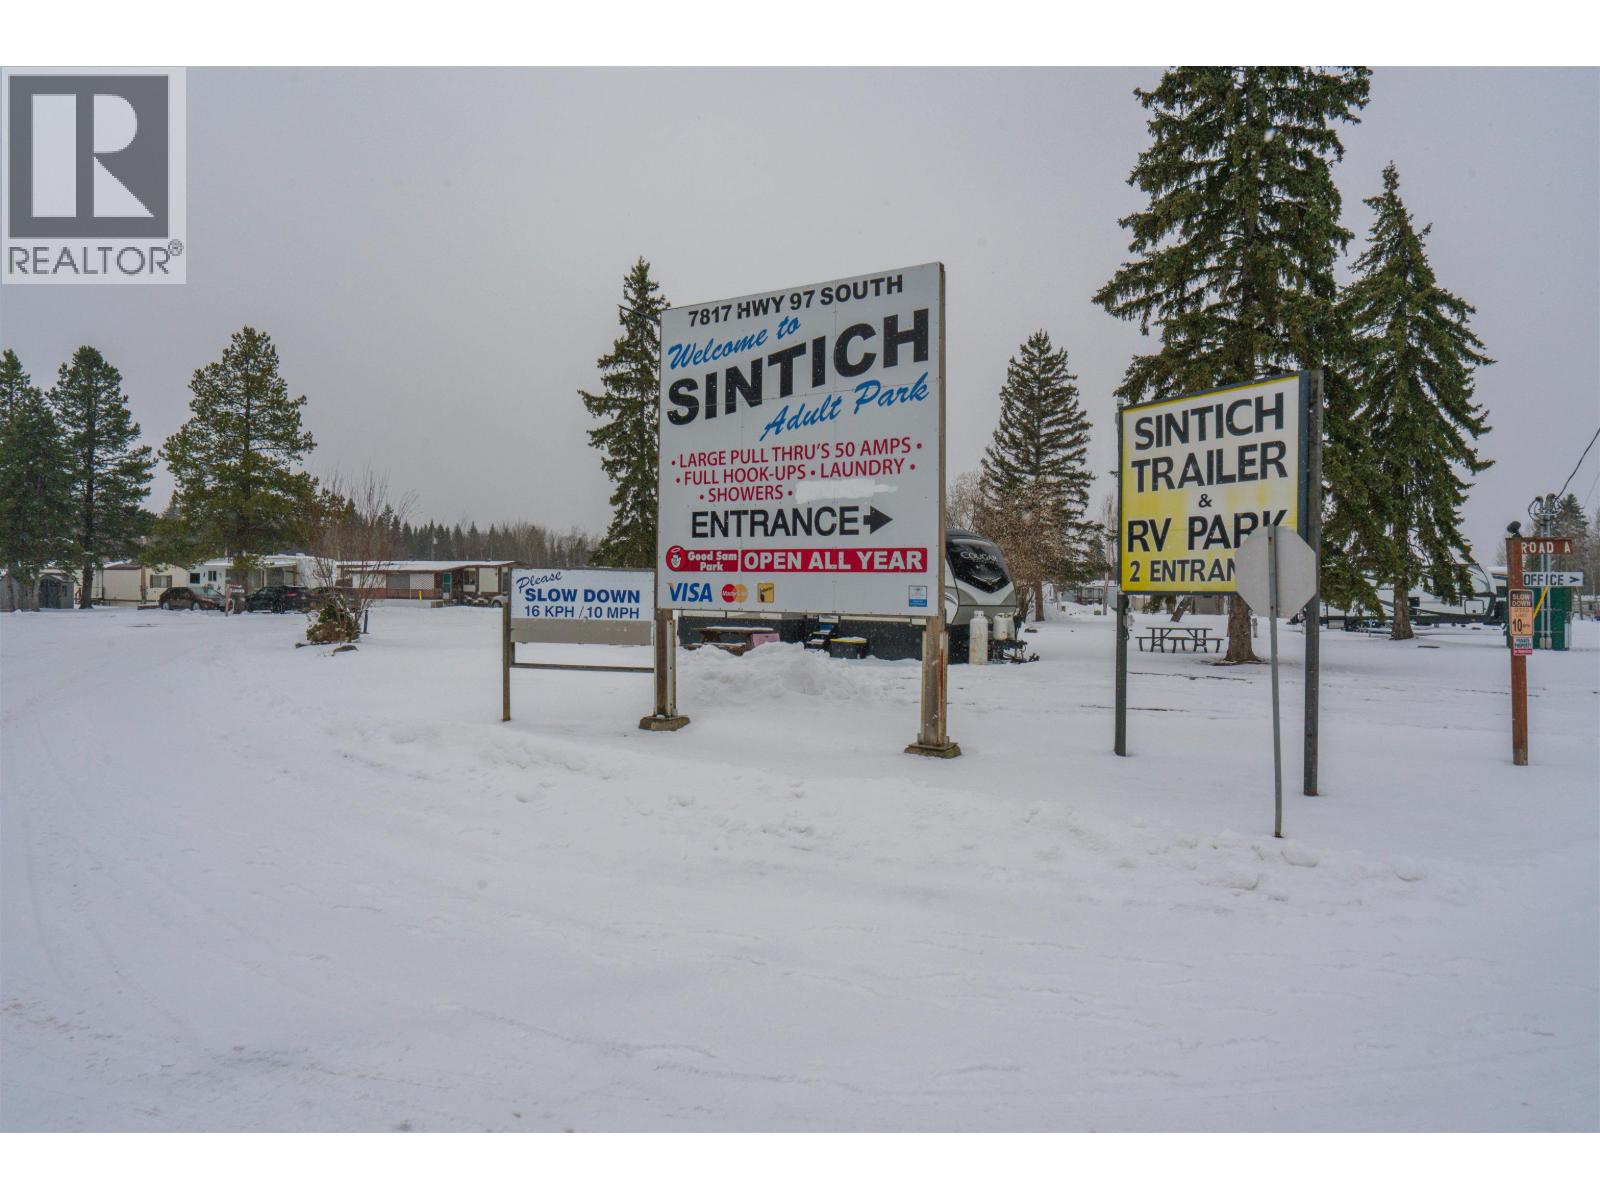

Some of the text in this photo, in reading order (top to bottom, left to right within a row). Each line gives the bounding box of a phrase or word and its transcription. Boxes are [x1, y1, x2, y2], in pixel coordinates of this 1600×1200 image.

[688, 274, 903, 327] 7817 HWY 97 SOUTH
[667, 315, 800, 370] Welcome to
[666, 308, 929, 426] SINTICH
[759, 371, 930, 442] Adult Park
[1135, 392, 1284, 450] SINTICH
[680, 437, 911, 468] LARGE PULL THRU'S 50 AMPS
[684, 458, 905, 486] FULL HOOK-UPS LAUNDRY
[1131, 440, 1288, 493] TRAILER
[708, 485, 783, 502] SHOWERS
[1198, 493, 1212, 508] &
[691, 505, 860, 538] ENTRANCE
[1127, 518, 1172, 552] RV
[687, 551, 737, 561] Good Sam
[1521, 542, 1571, 554] ROAD A
[700, 562, 724, 571] Park
[744, 550, 923, 570] OPEN ALL YEAR
[1129, 560, 1140, 582] 2
[516, 571, 562, 593] Please
[1523, 574, 1564, 586] OFFICE
[525, 588, 640, 603] SLOW DOWN
[666, 582, 713, 602] VISA
[525, 605, 540, 617] 16
[545, 605, 574, 618] KPH
[587, 607, 602, 619] 10
[607, 607, 640, 619] MPH
[1512, 618, 1523, 632] 10
